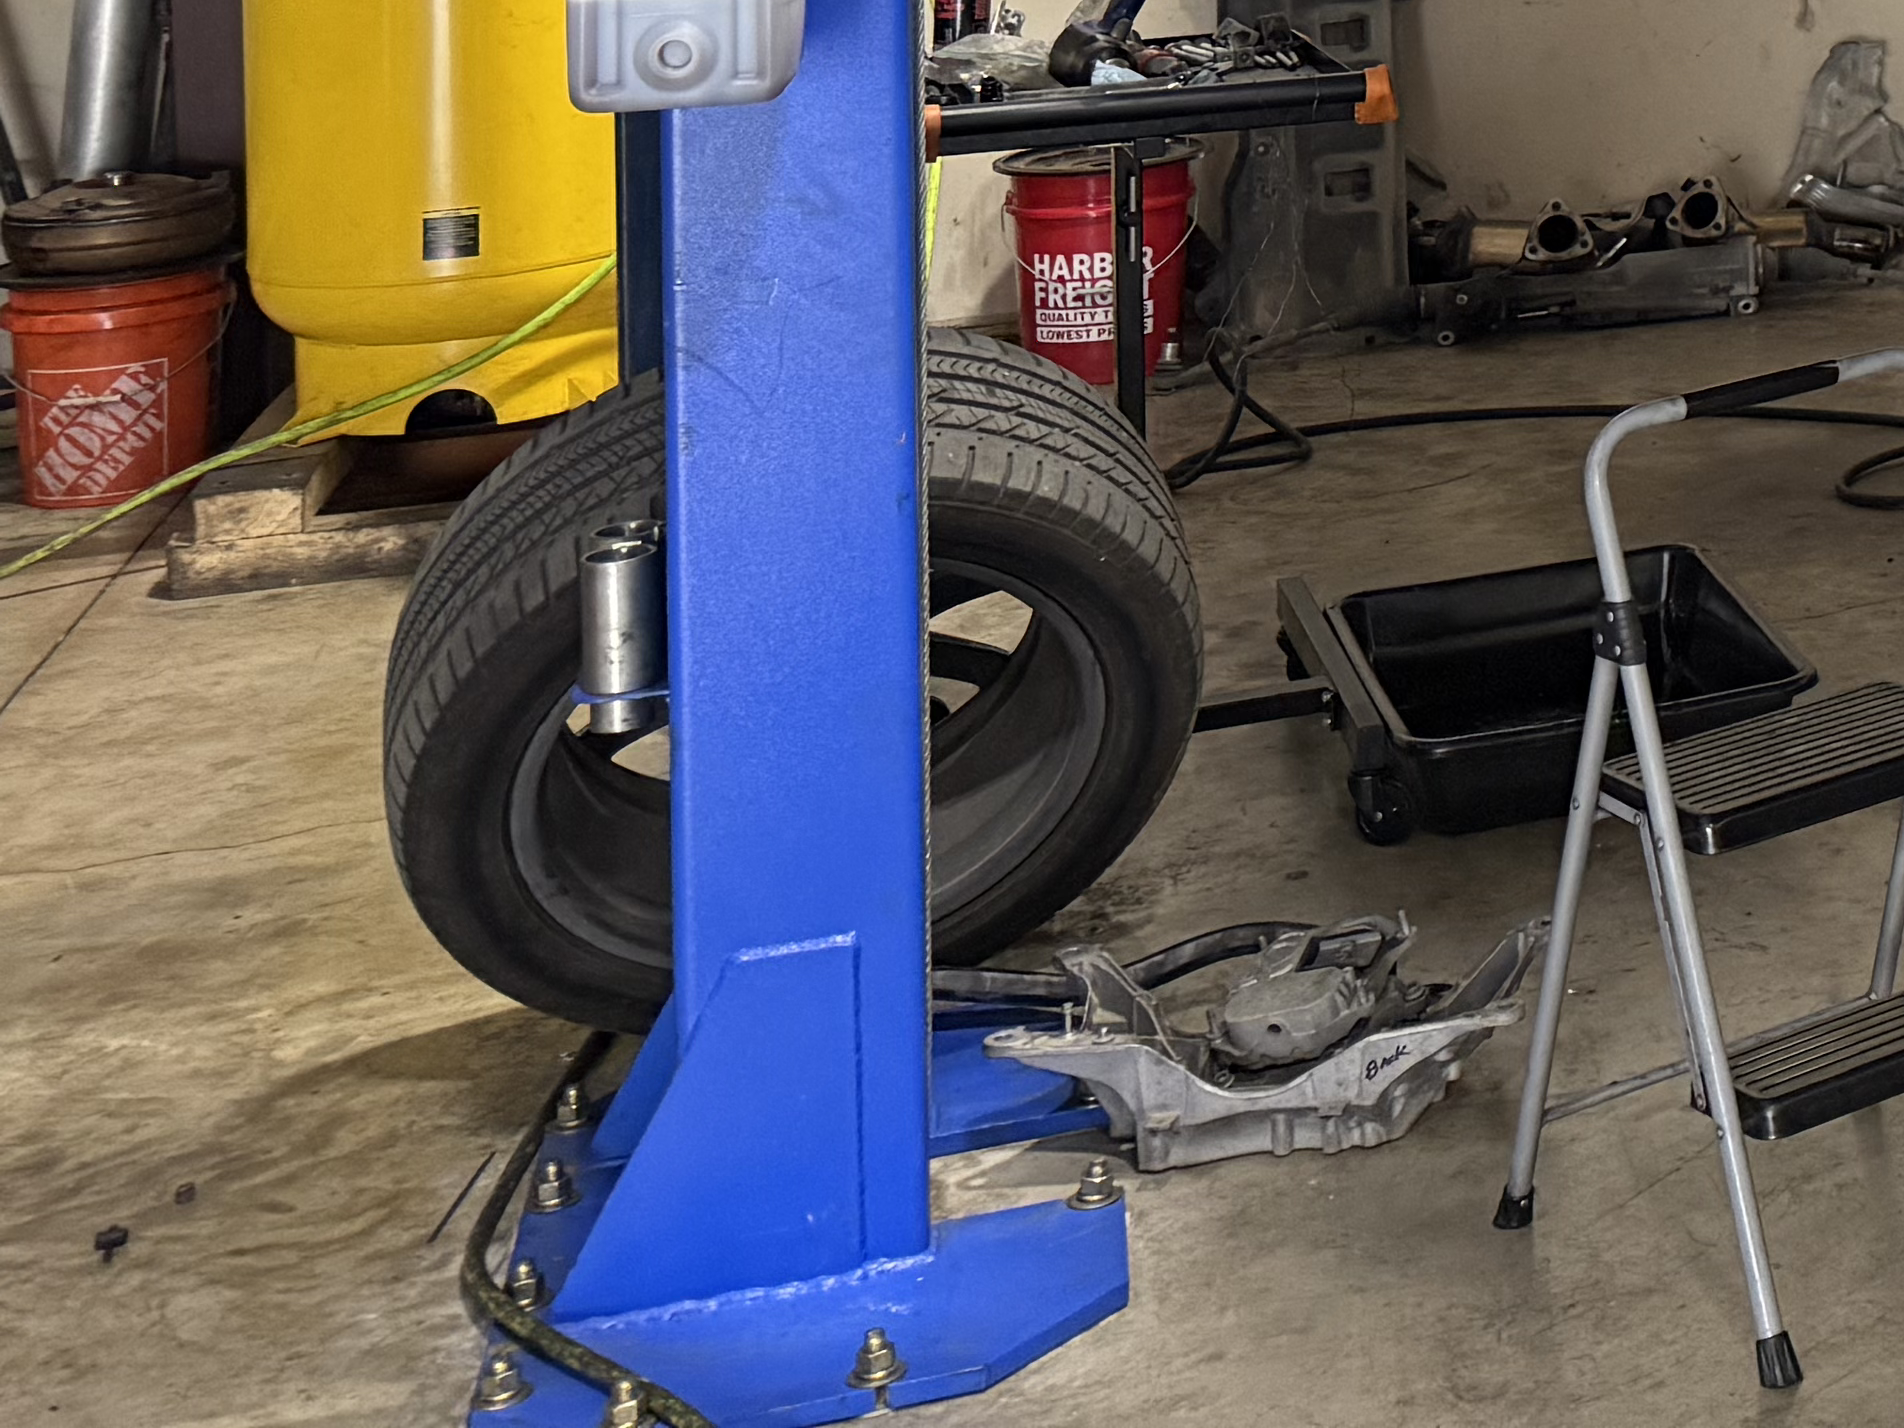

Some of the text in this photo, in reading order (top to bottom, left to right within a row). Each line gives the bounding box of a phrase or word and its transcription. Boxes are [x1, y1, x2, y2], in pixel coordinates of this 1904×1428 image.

[1034, 246, 1153, 280] HARBR
[1034, 272, 1154, 308] FREIGT
[1040, 311, 1098, 322] QUALITY
[1040, 328, 1092, 340] LOWEST
[34, 365, 167, 497] HOME
[78, 408, 166, 495] DEPOT
